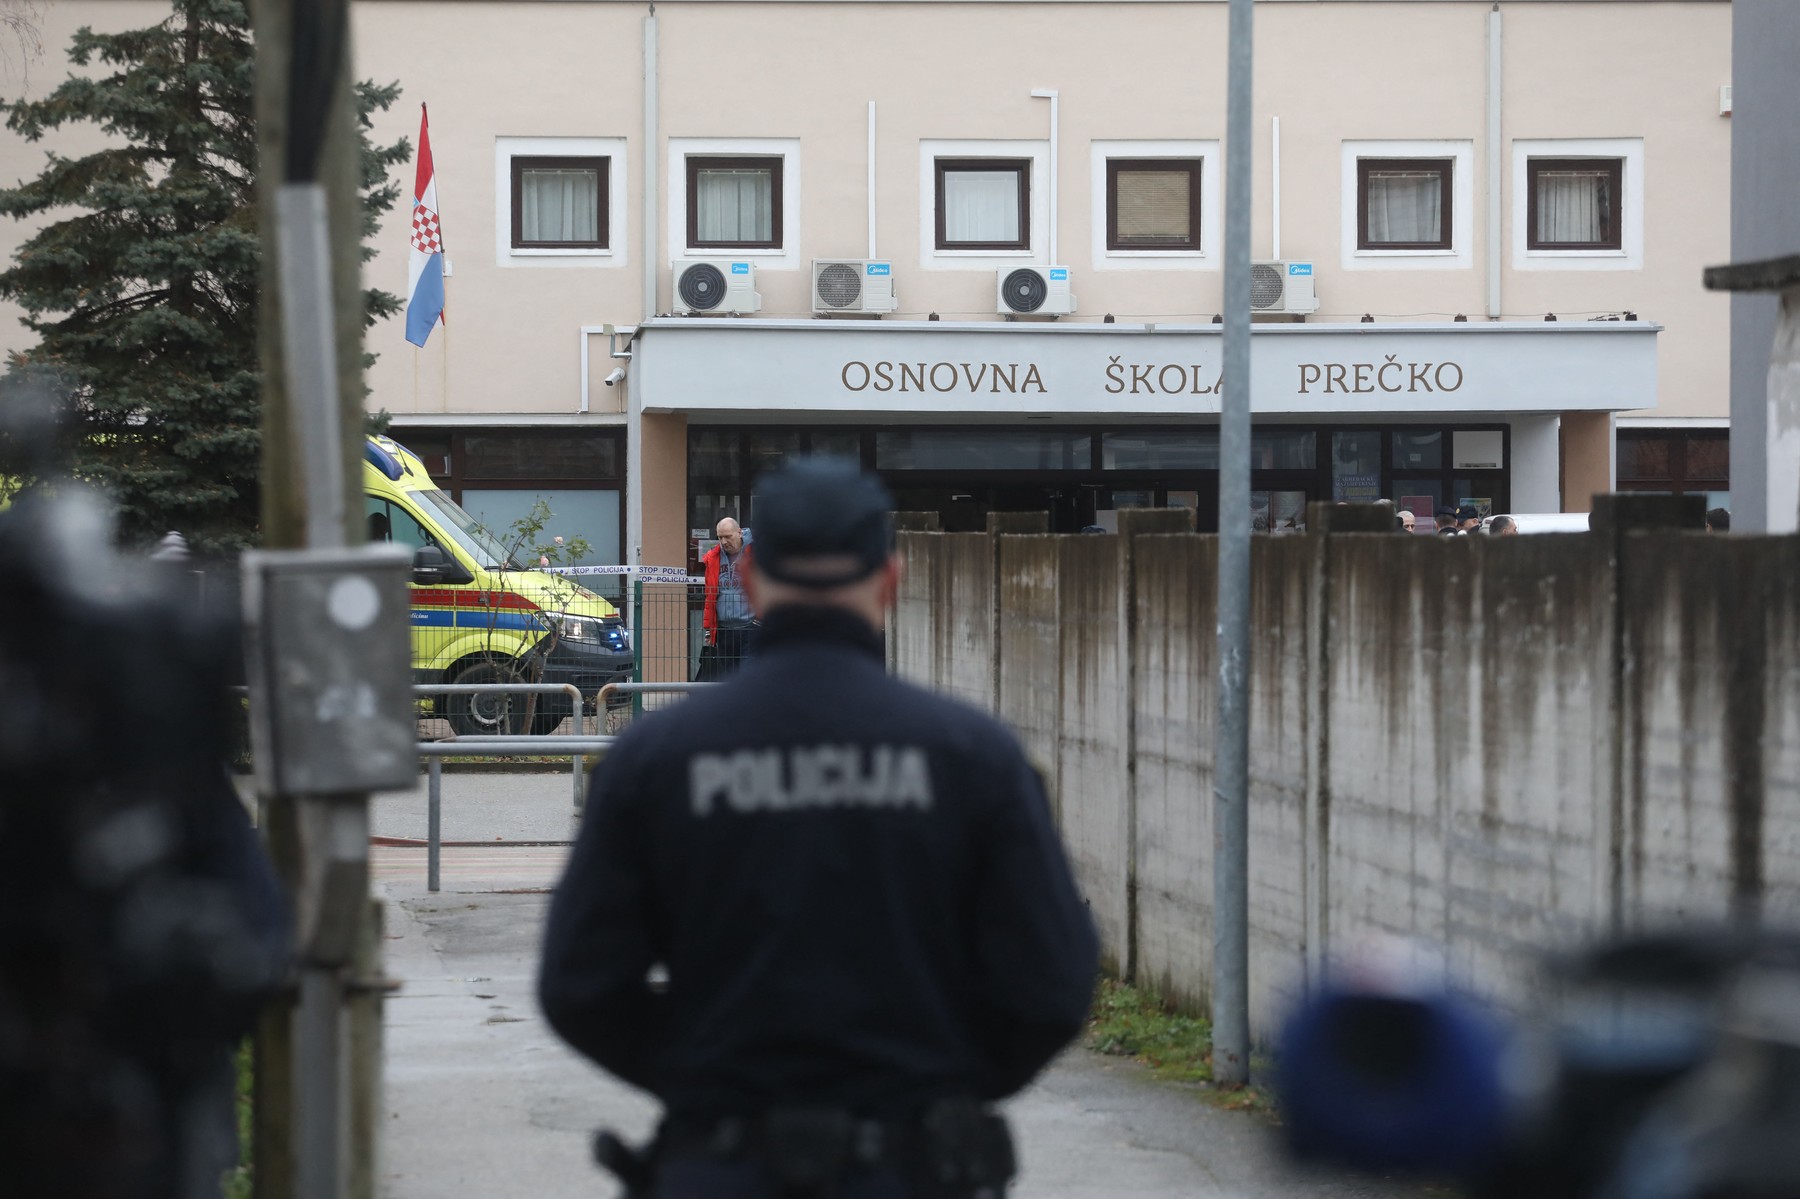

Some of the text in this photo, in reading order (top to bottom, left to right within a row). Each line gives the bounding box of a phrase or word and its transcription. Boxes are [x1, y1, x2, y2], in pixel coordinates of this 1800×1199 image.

[841, 361, 1048, 393] OSNOVNA
[1298, 354, 1464, 393] PREČKO
[662, 567, 687, 576] POLICI
[690, 748, 932, 816] POLICIJA
